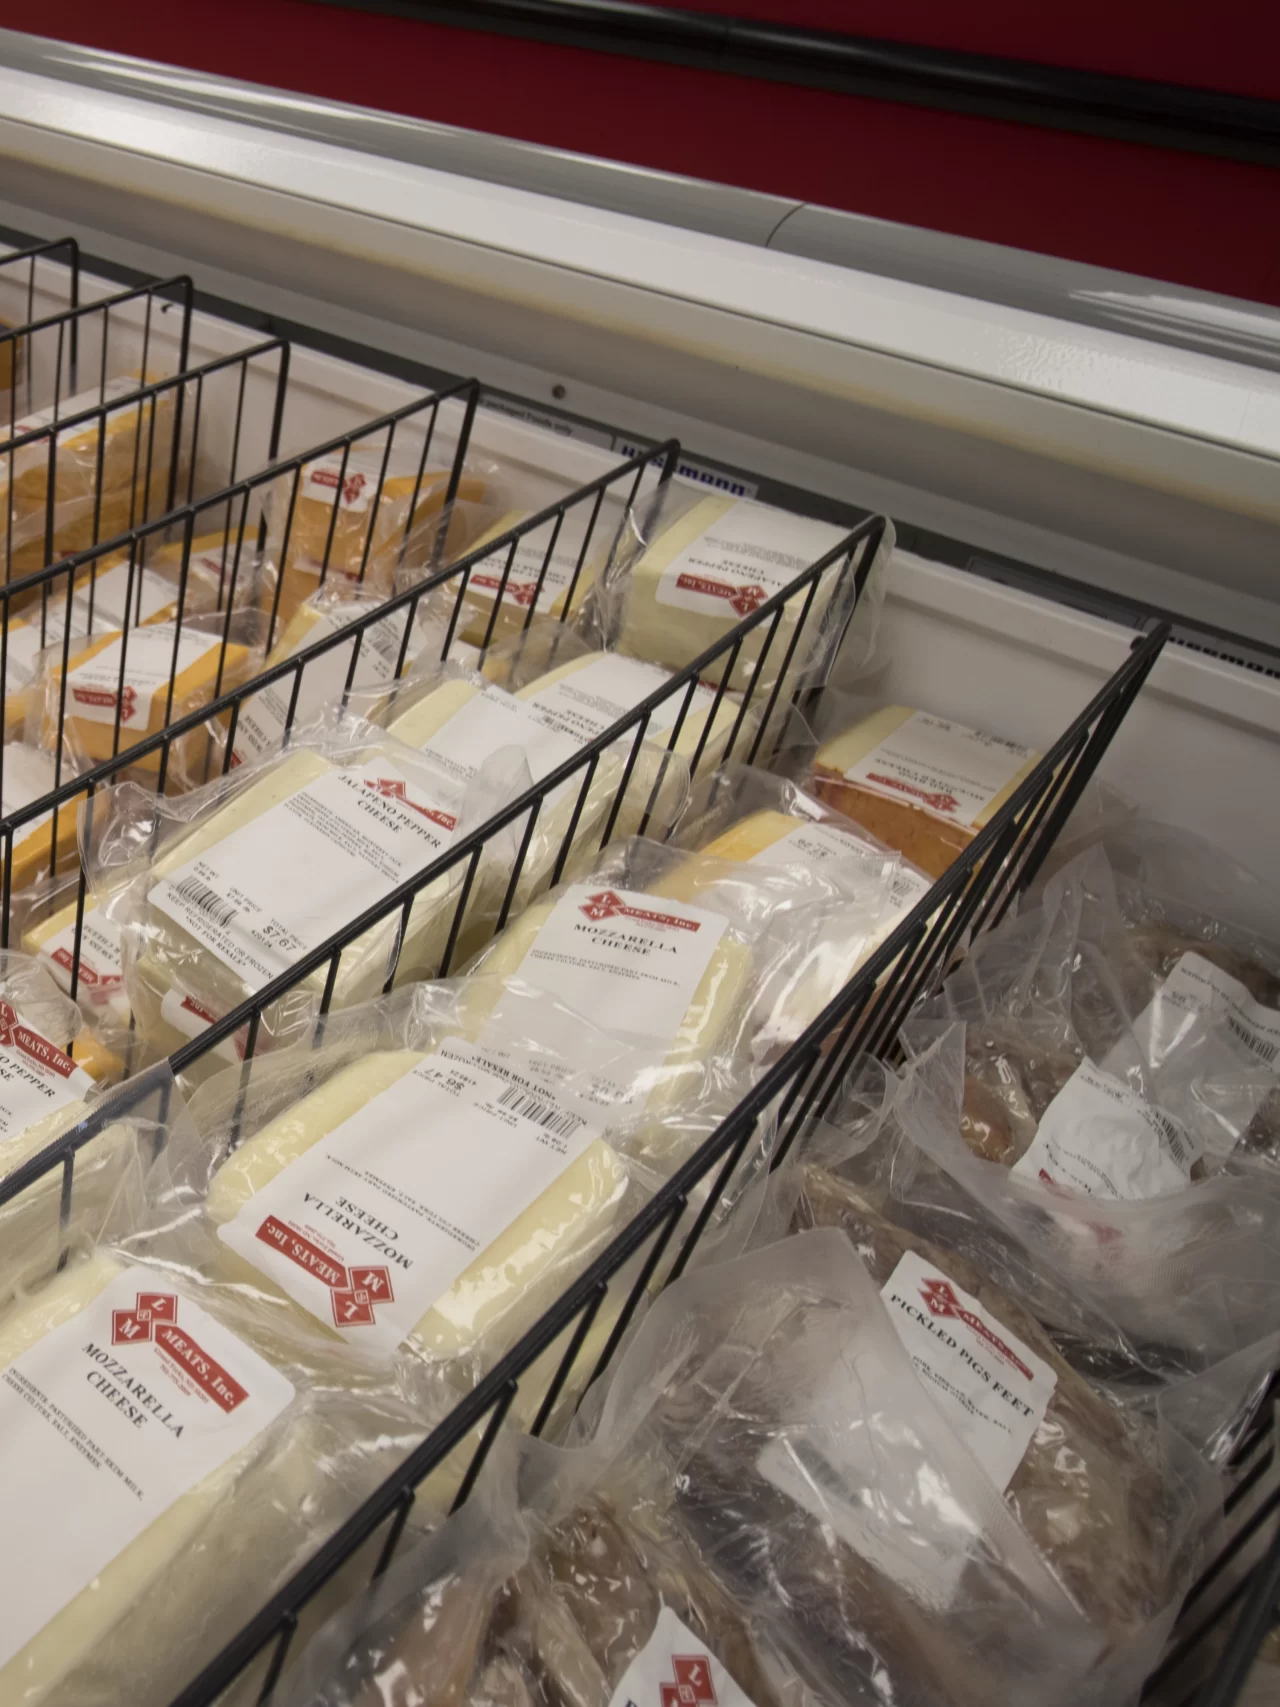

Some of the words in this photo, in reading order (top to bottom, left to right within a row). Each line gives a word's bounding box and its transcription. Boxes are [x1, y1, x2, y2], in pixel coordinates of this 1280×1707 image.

[337, 775, 397, 815] JALAPENO
[396, 813, 442, 849] PEPPER
[357, 799, 402, 833] CHEESE
[261, 925, 297, 951] $7.67
[573, 923, 677, 955] MOZZARELLA
[591, 937, 649, 955] CHEESE
[17, 1031, 51, 1061] MEATS,
[51, 1053, 78, 1072] Inc.
[9, 1063, 57, 1098] PEPPER
[265, 1221, 289, 1247] Inc.
[303, 1193, 412, 1270] MOZZARELLA
[335, 1197, 399, 1241] CHEESE
[291, 1239, 341, 1285] MEATS,
[119, 1317, 141, 1339] M
[161, 1329, 211, 1381] MEATS,
[211, 1375, 235, 1407] Inc.
[889, 1293, 957, 1349] PICKLED
[959, 1347, 991, 1383] PIGS
[991, 1381, 1035, 1417] FEET
[82, 1343, 185, 1439] MOZZARELLA
[85, 1371, 148, 1425] CHEESE
